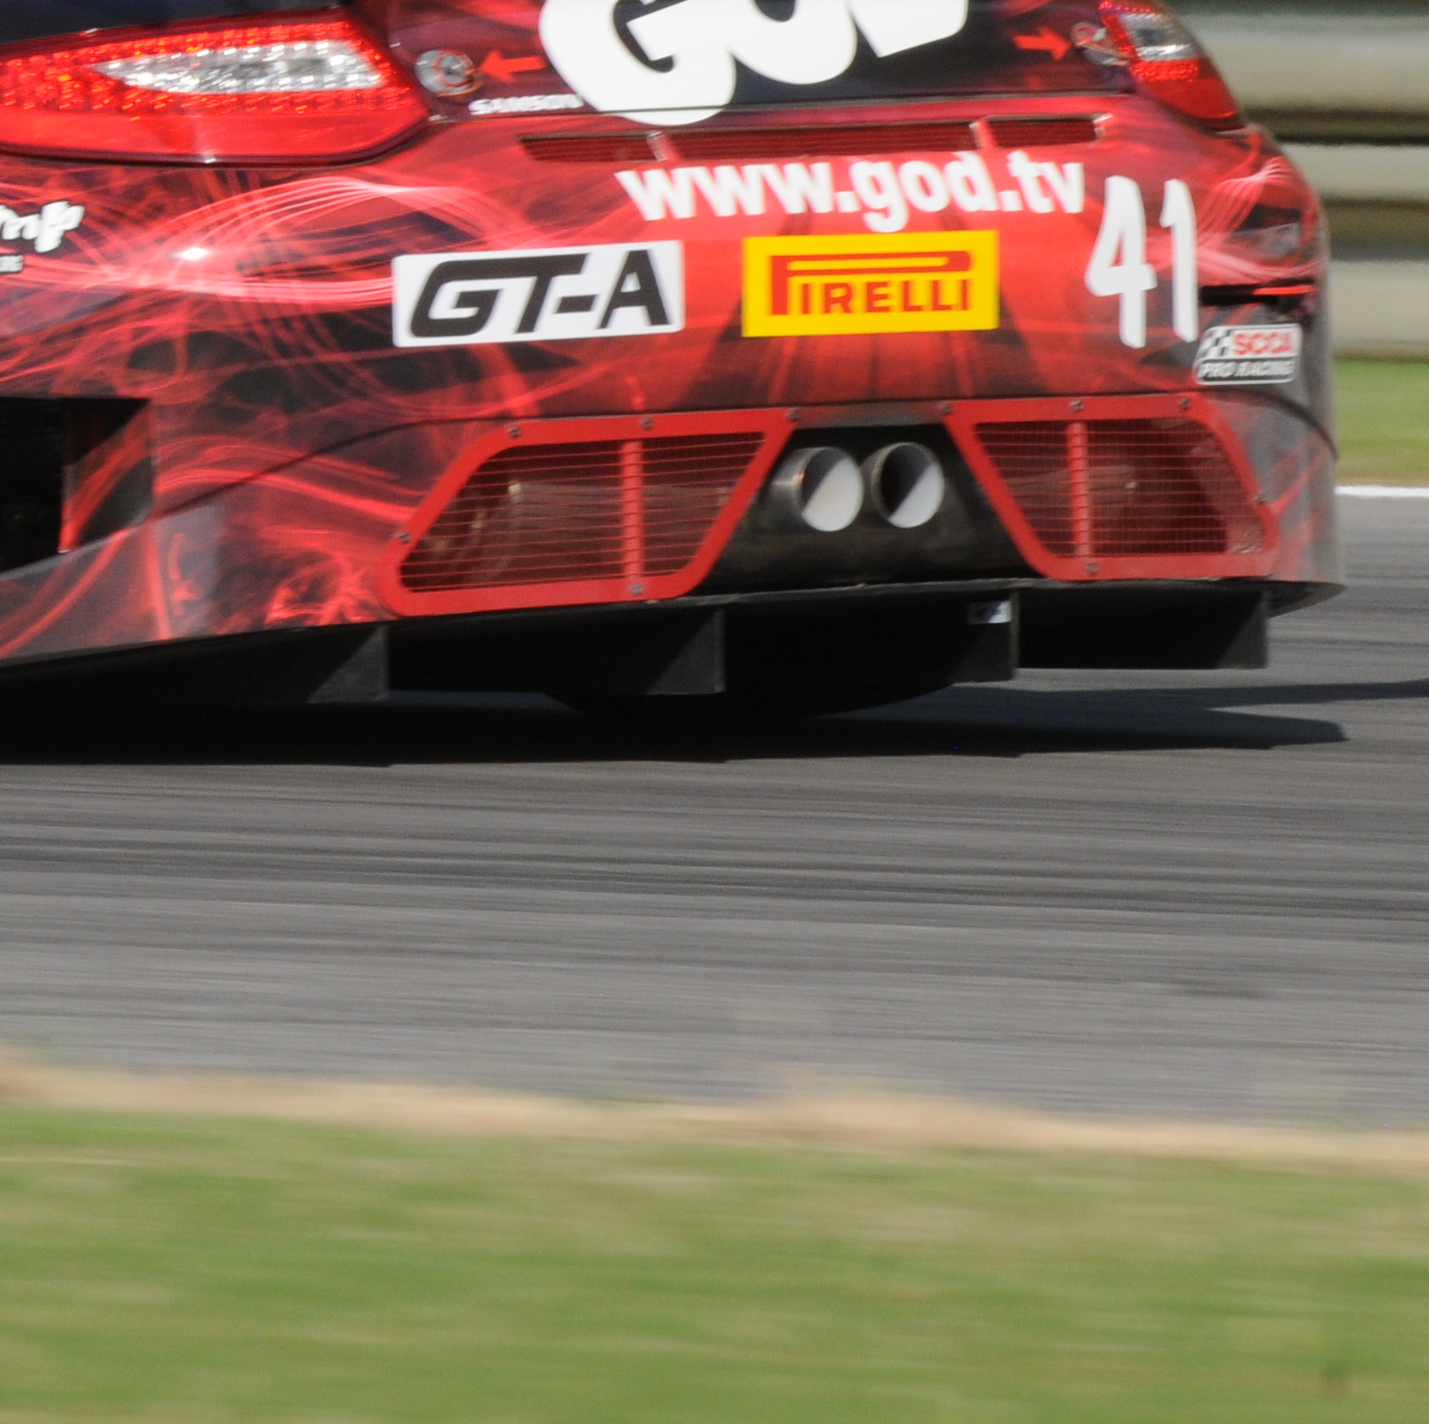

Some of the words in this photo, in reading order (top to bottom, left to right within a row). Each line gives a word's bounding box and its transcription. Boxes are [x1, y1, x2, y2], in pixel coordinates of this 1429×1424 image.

[617, 151, 1083, 232] www.god.tv
[409, 248, 670, 338] GT-A
[769, 250, 973, 317] PIRELLI
[1084, 175, 1199, 348] 41
[1198, 361, 1237, 378] PRO
